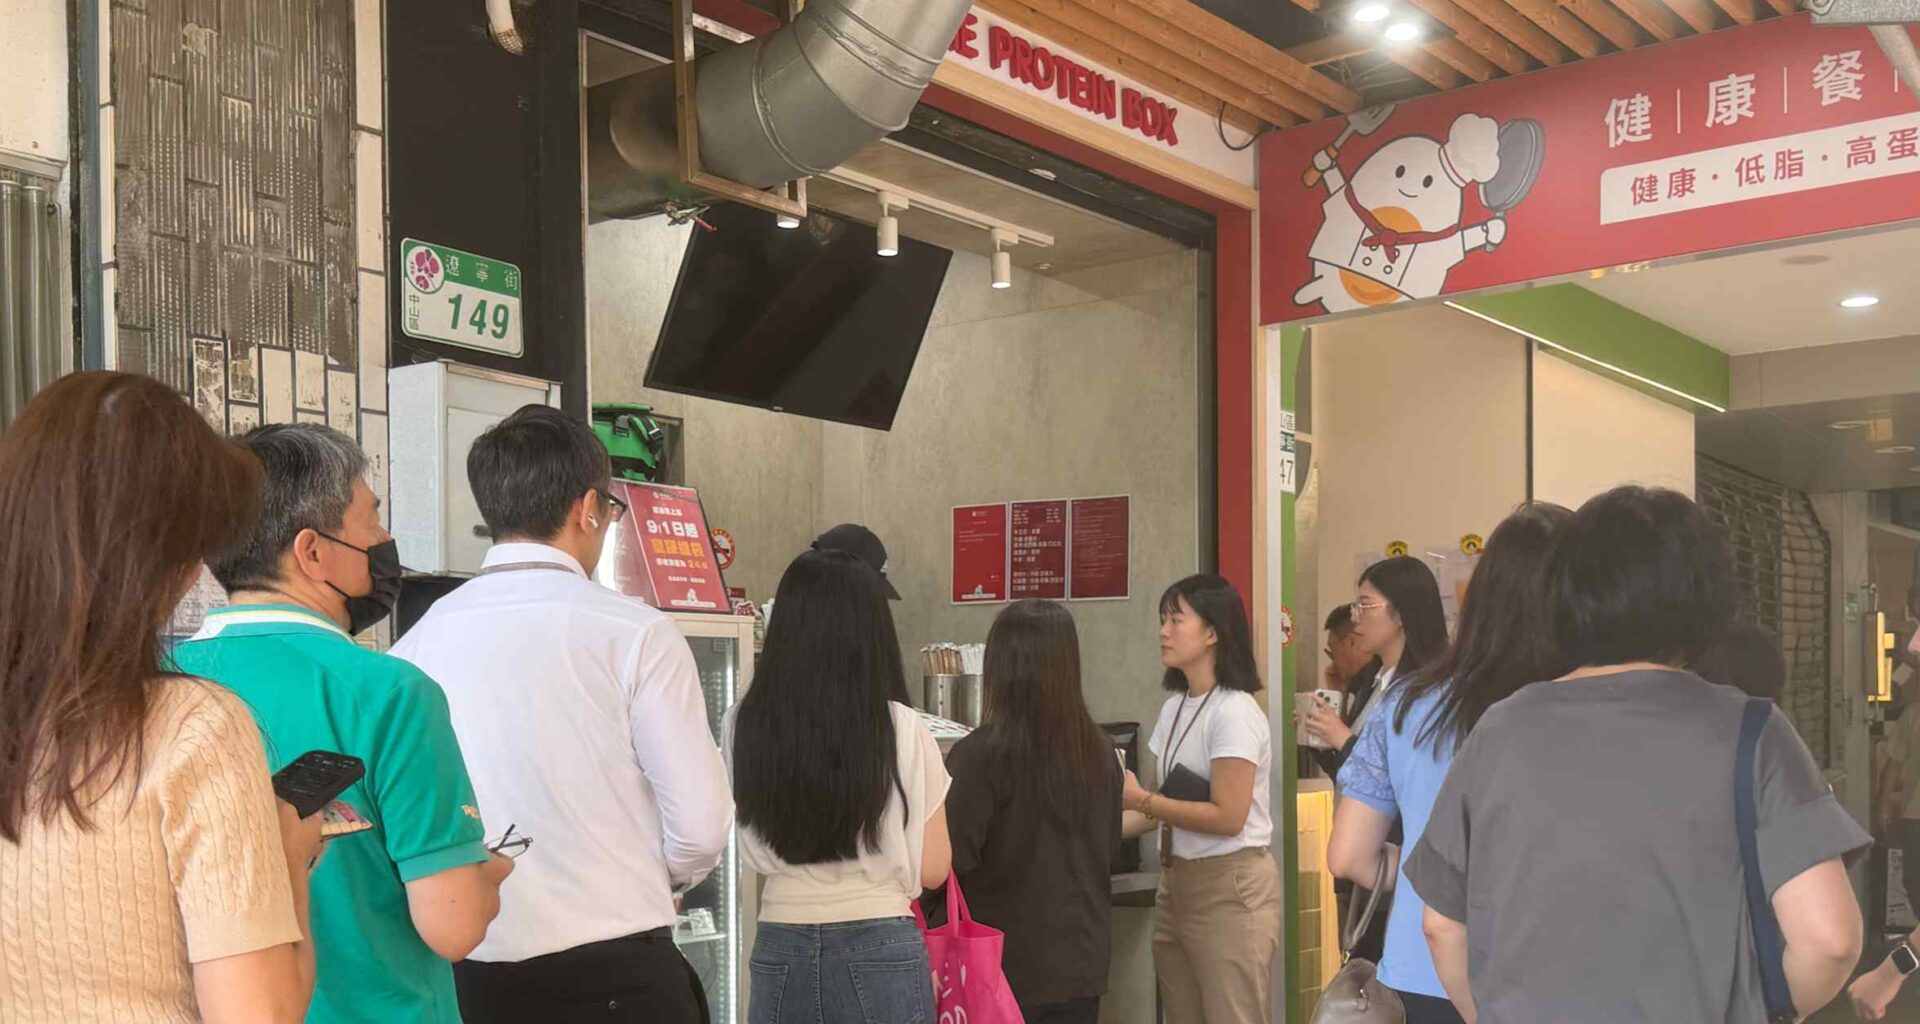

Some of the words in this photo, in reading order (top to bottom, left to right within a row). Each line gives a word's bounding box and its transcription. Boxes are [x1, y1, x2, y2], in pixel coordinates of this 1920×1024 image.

[988, 25, 1117, 120] PROTEIN
[1121, 87, 1178, 146] BOX
[447, 293, 510, 340] 149
